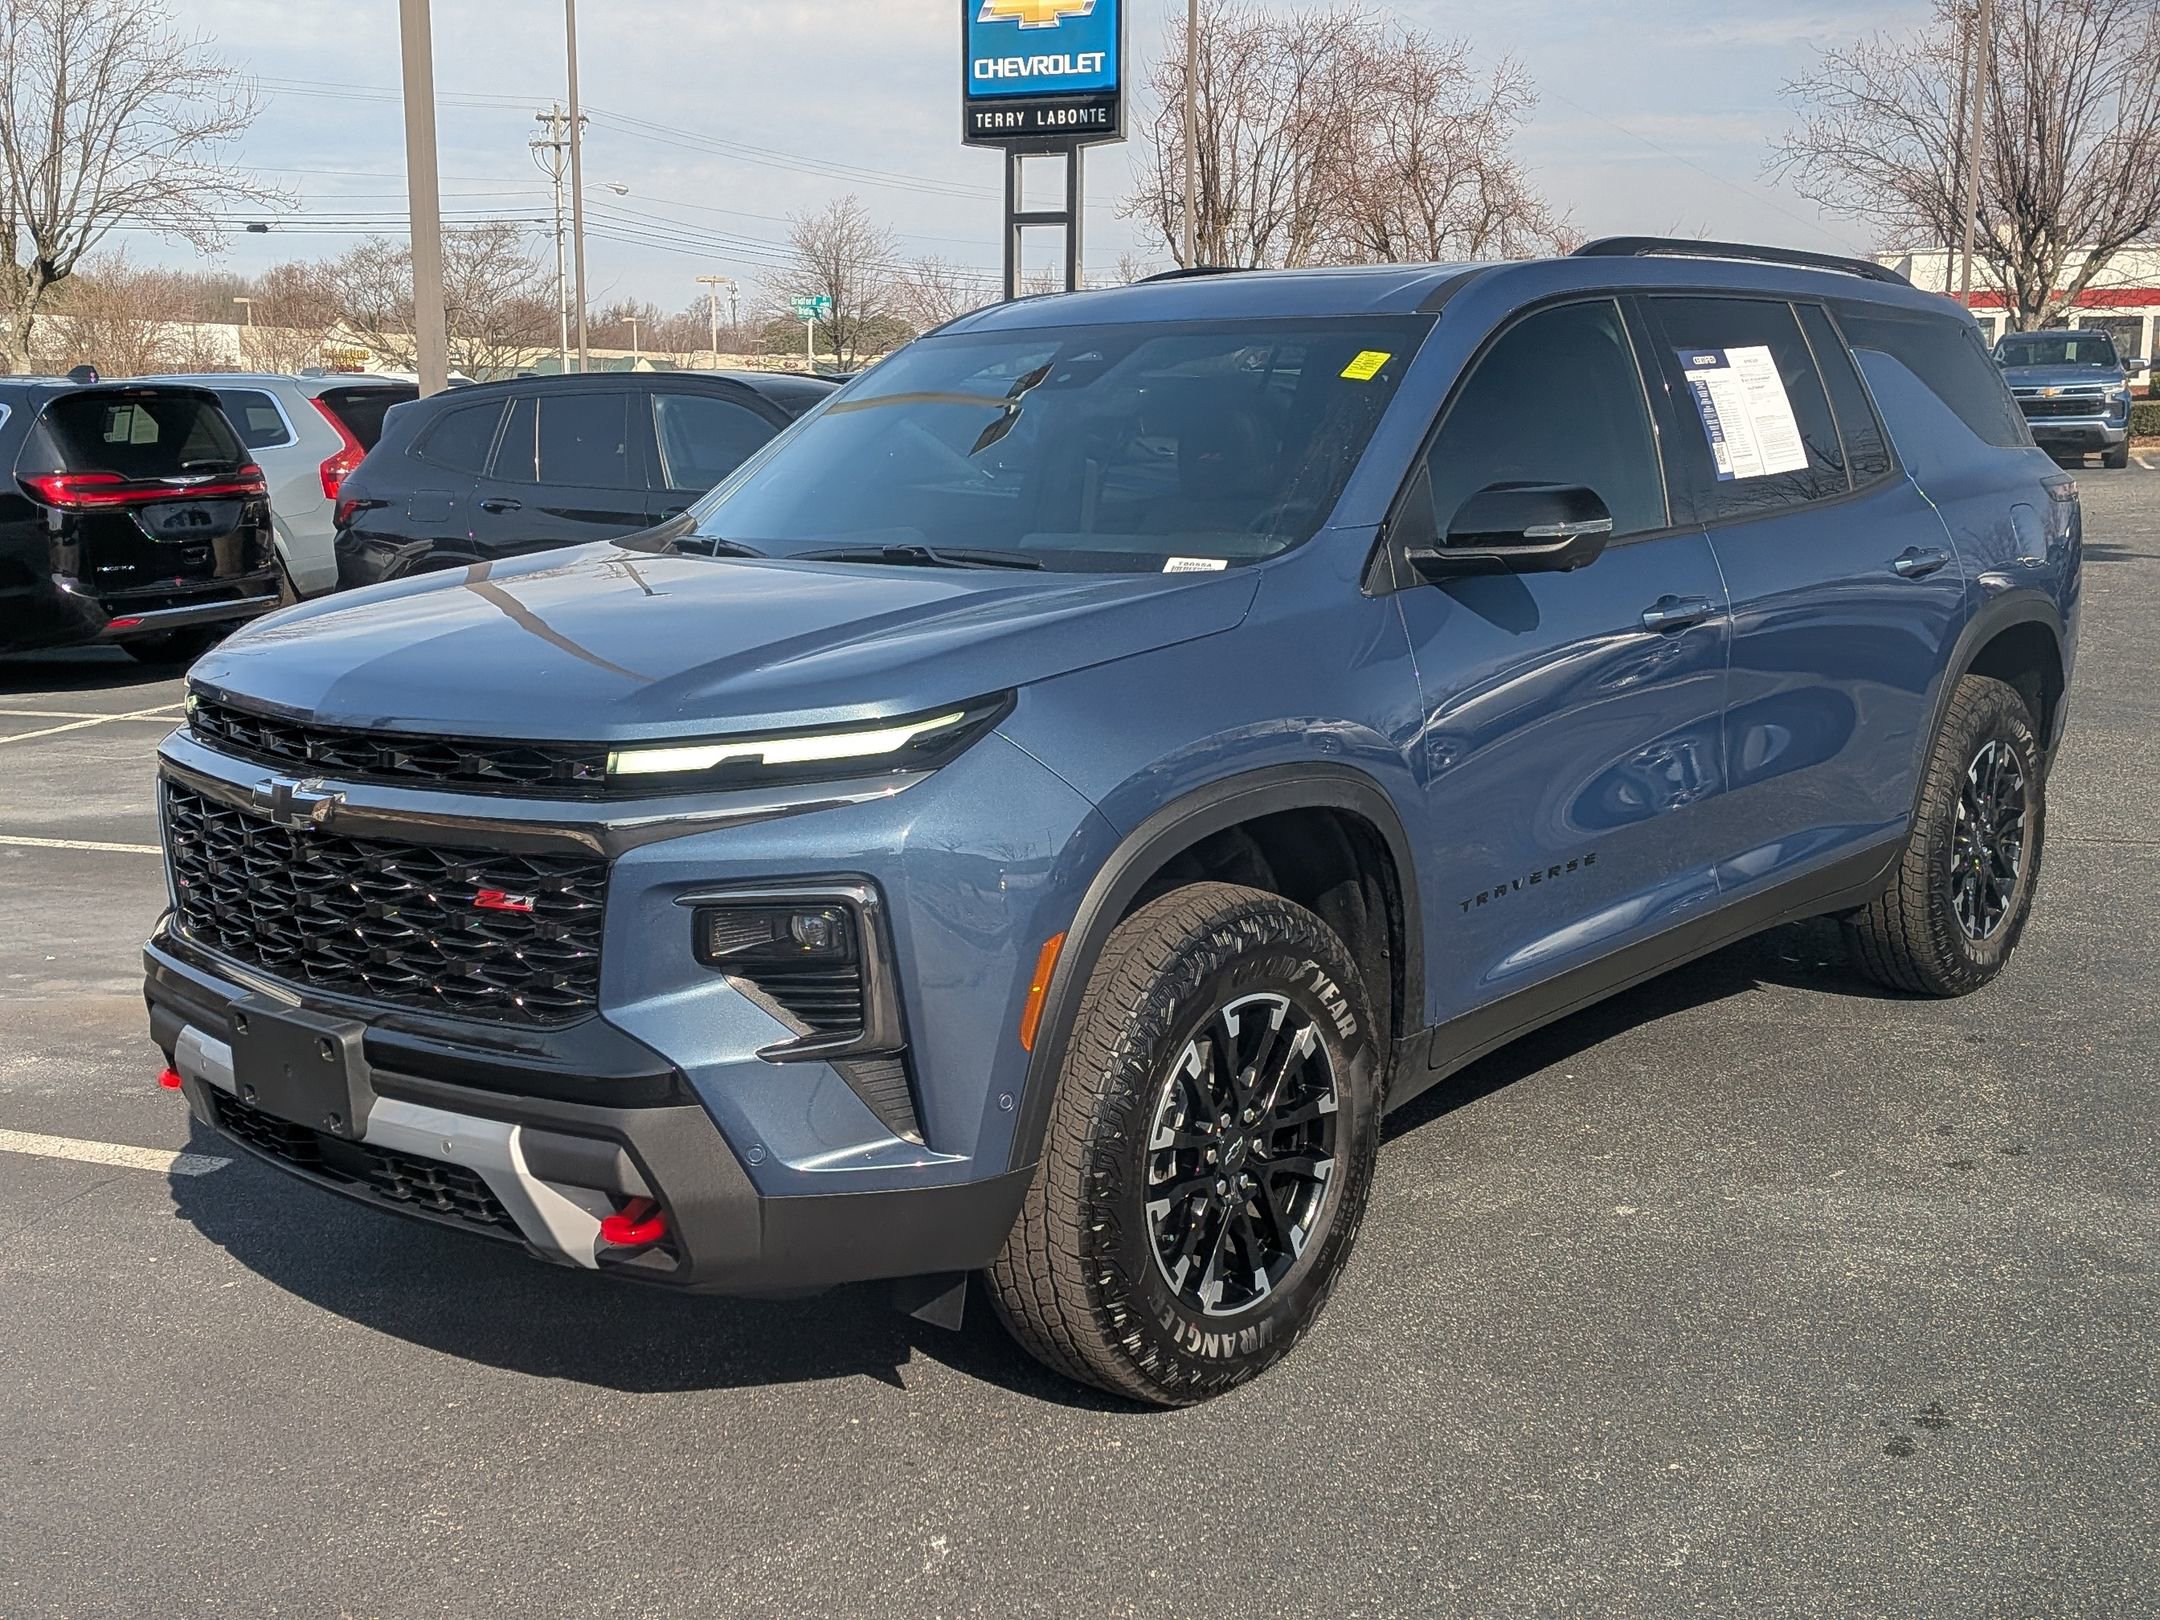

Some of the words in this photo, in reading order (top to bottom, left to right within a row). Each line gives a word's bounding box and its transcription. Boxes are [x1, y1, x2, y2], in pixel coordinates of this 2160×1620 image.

[974, 52, 1105, 79] CHEVROLET
[976, 112, 1024, 128] TERRY
[1037, 108, 1106, 125] LABONTE
[1459, 853, 1597, 913] TRAVERSE
[474, 889, 536, 912] Z71
